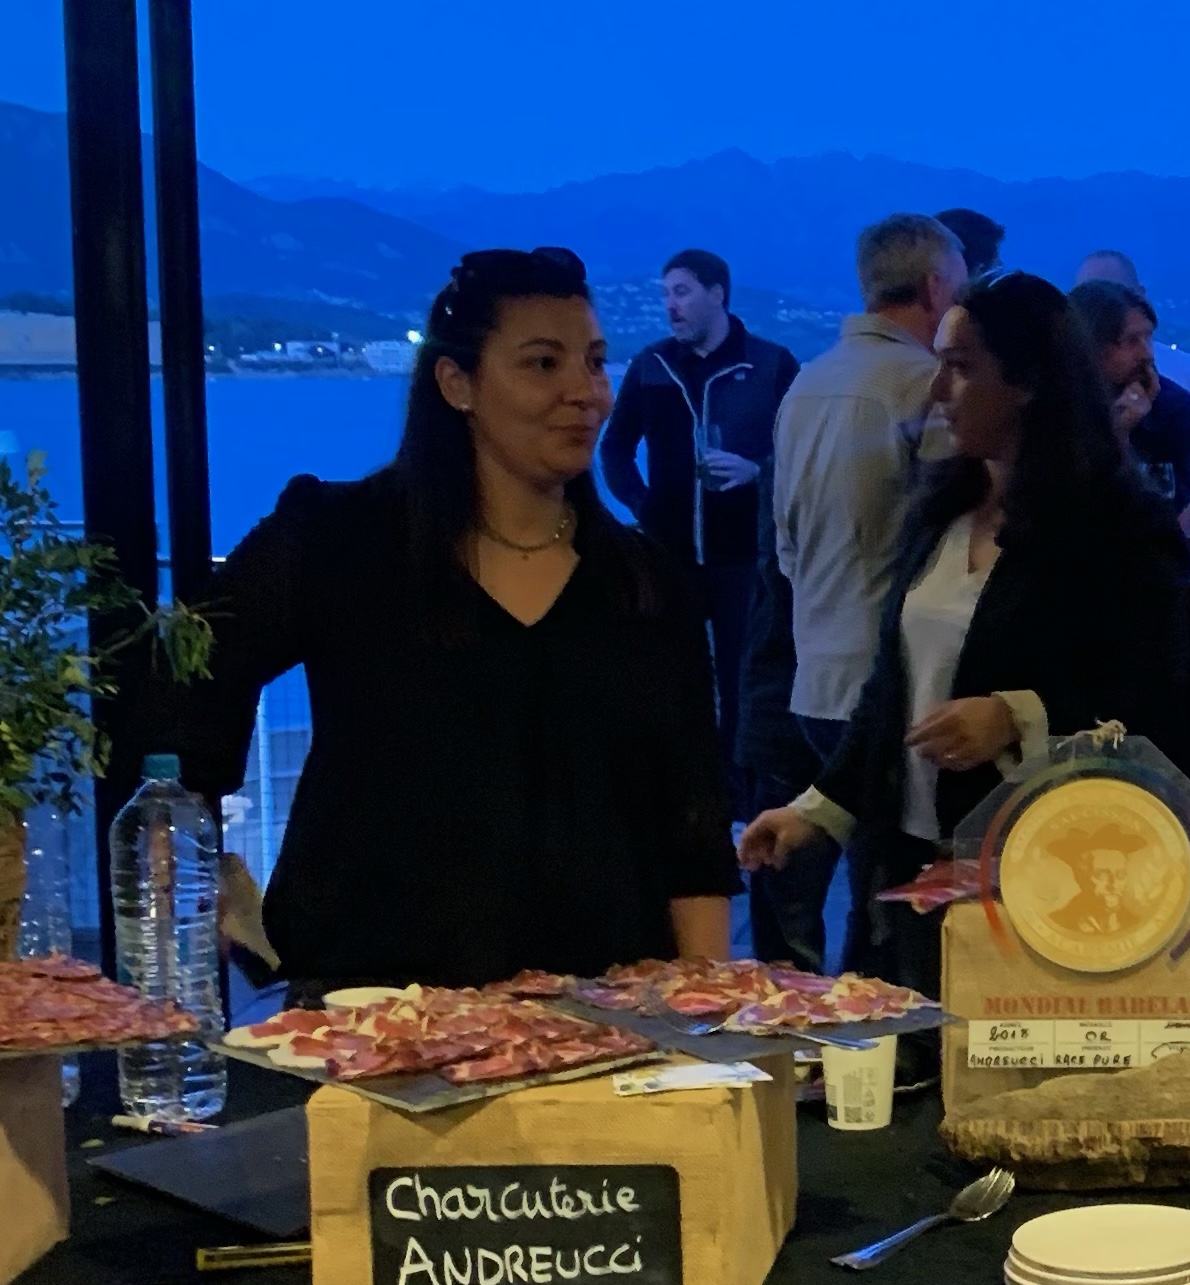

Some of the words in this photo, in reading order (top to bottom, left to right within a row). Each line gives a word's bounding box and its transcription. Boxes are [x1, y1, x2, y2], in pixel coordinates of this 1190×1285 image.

[982, 996, 1086, 1015] MONDIAL
[1085, 1030, 1112, 1042] OR
[386, 1173, 641, 1222] Charcuterie
